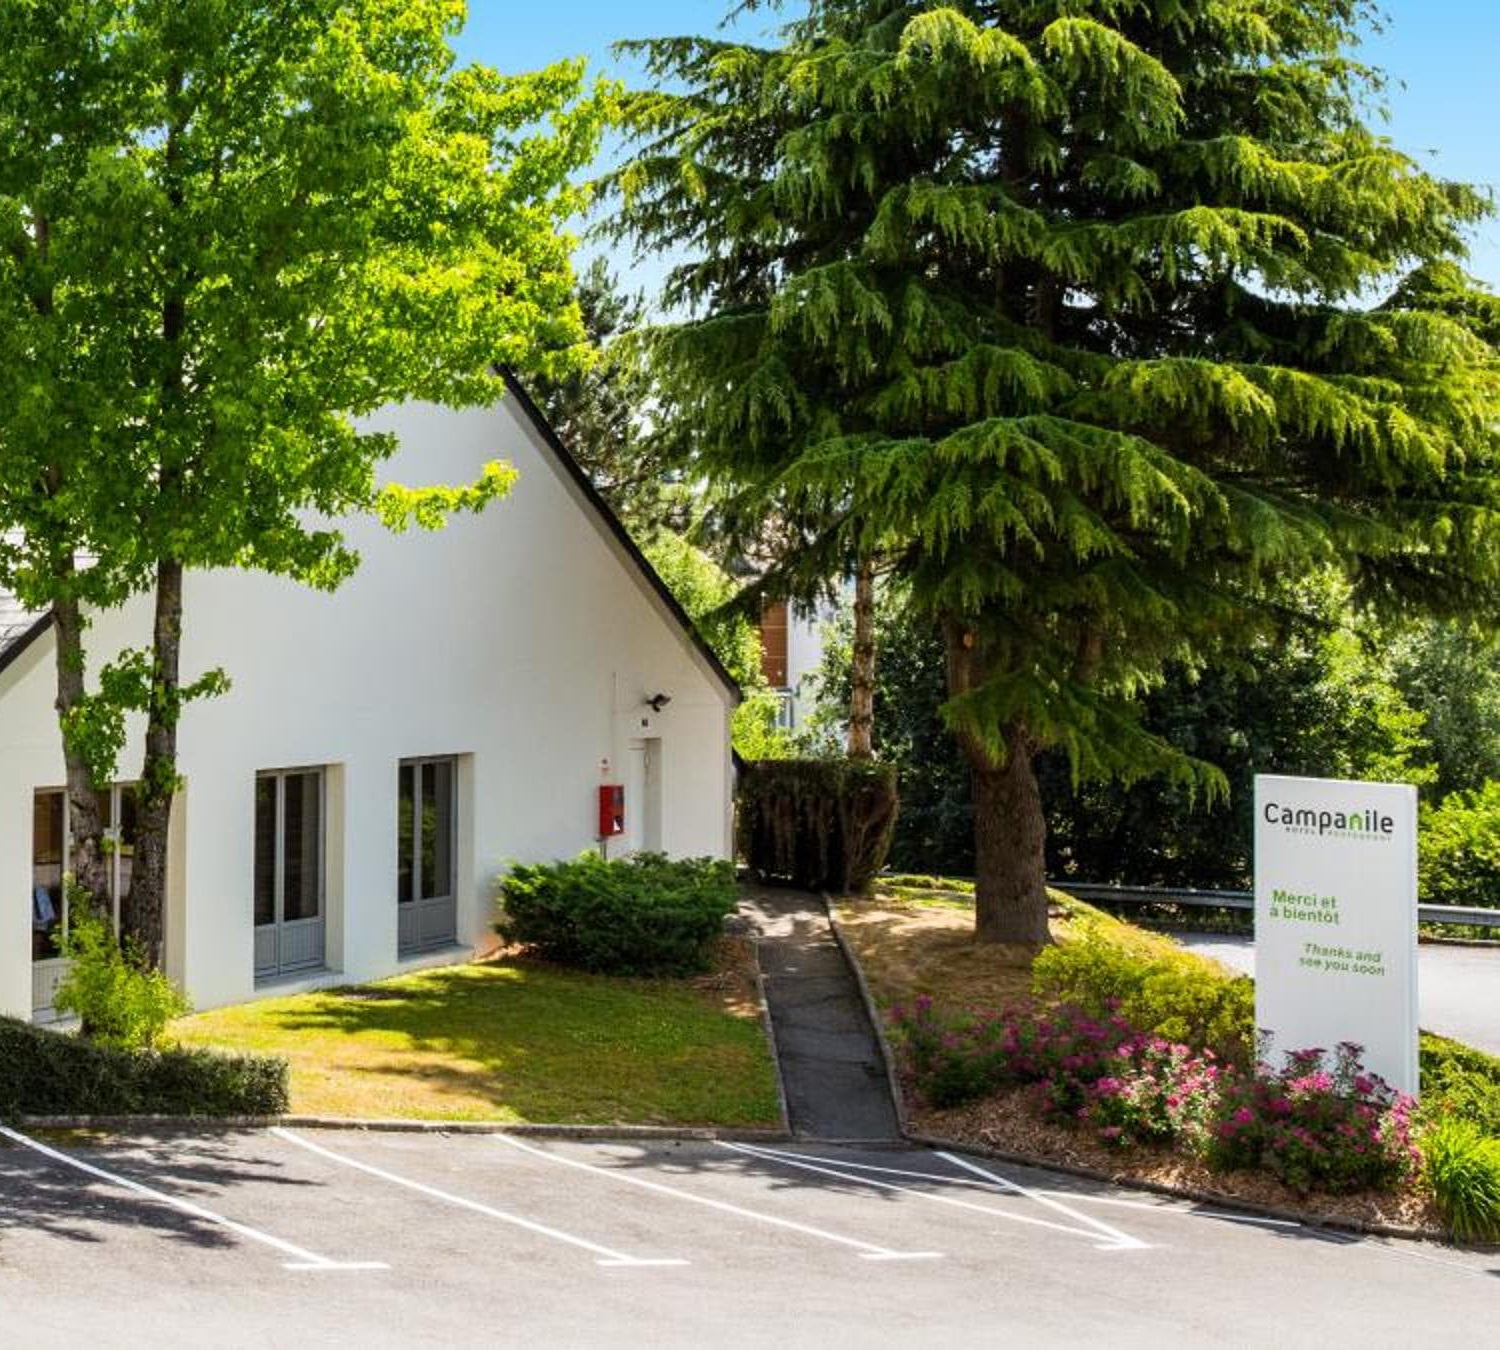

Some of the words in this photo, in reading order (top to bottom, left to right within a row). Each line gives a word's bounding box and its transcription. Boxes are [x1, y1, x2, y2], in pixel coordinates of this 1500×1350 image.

[1264, 803, 1394, 836] Campanile
[1272, 889, 1317, 907] Merci
[1321, 895, 1337, 909] et
[1304, 943, 1353, 959] Thanks
[1355, 950, 1382, 963] and
[1299, 957, 1322, 968] see
[1324, 960, 1349, 972] you
[1352, 963, 1385, 977] soon
